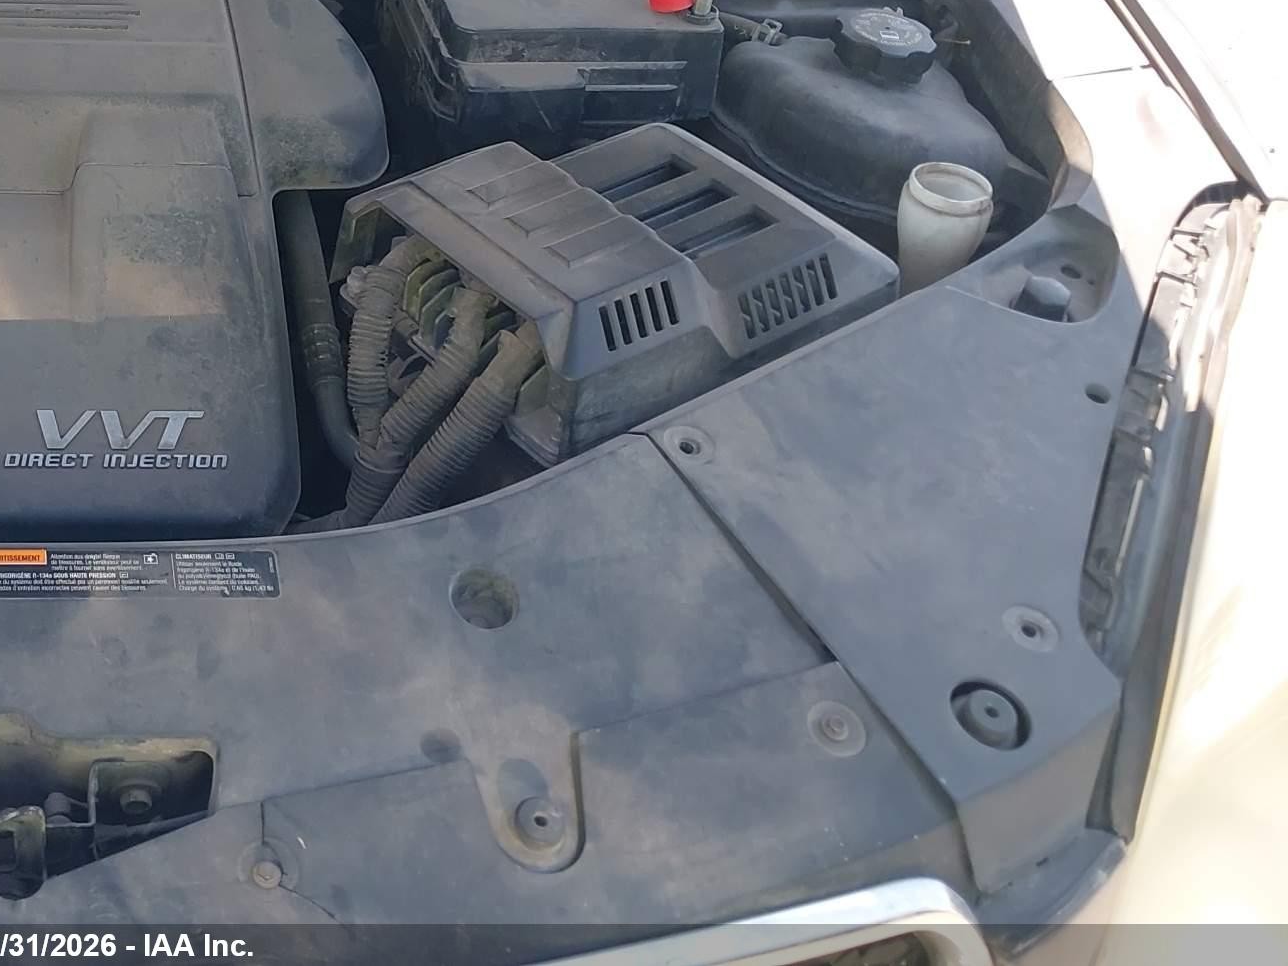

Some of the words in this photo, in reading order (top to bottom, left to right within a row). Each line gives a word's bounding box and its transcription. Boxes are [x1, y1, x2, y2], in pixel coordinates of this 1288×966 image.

[37, 410, 205, 450] VVT
[4, 453, 93, 468] DIRECT
[104, 453, 227, 468] INJECTION
